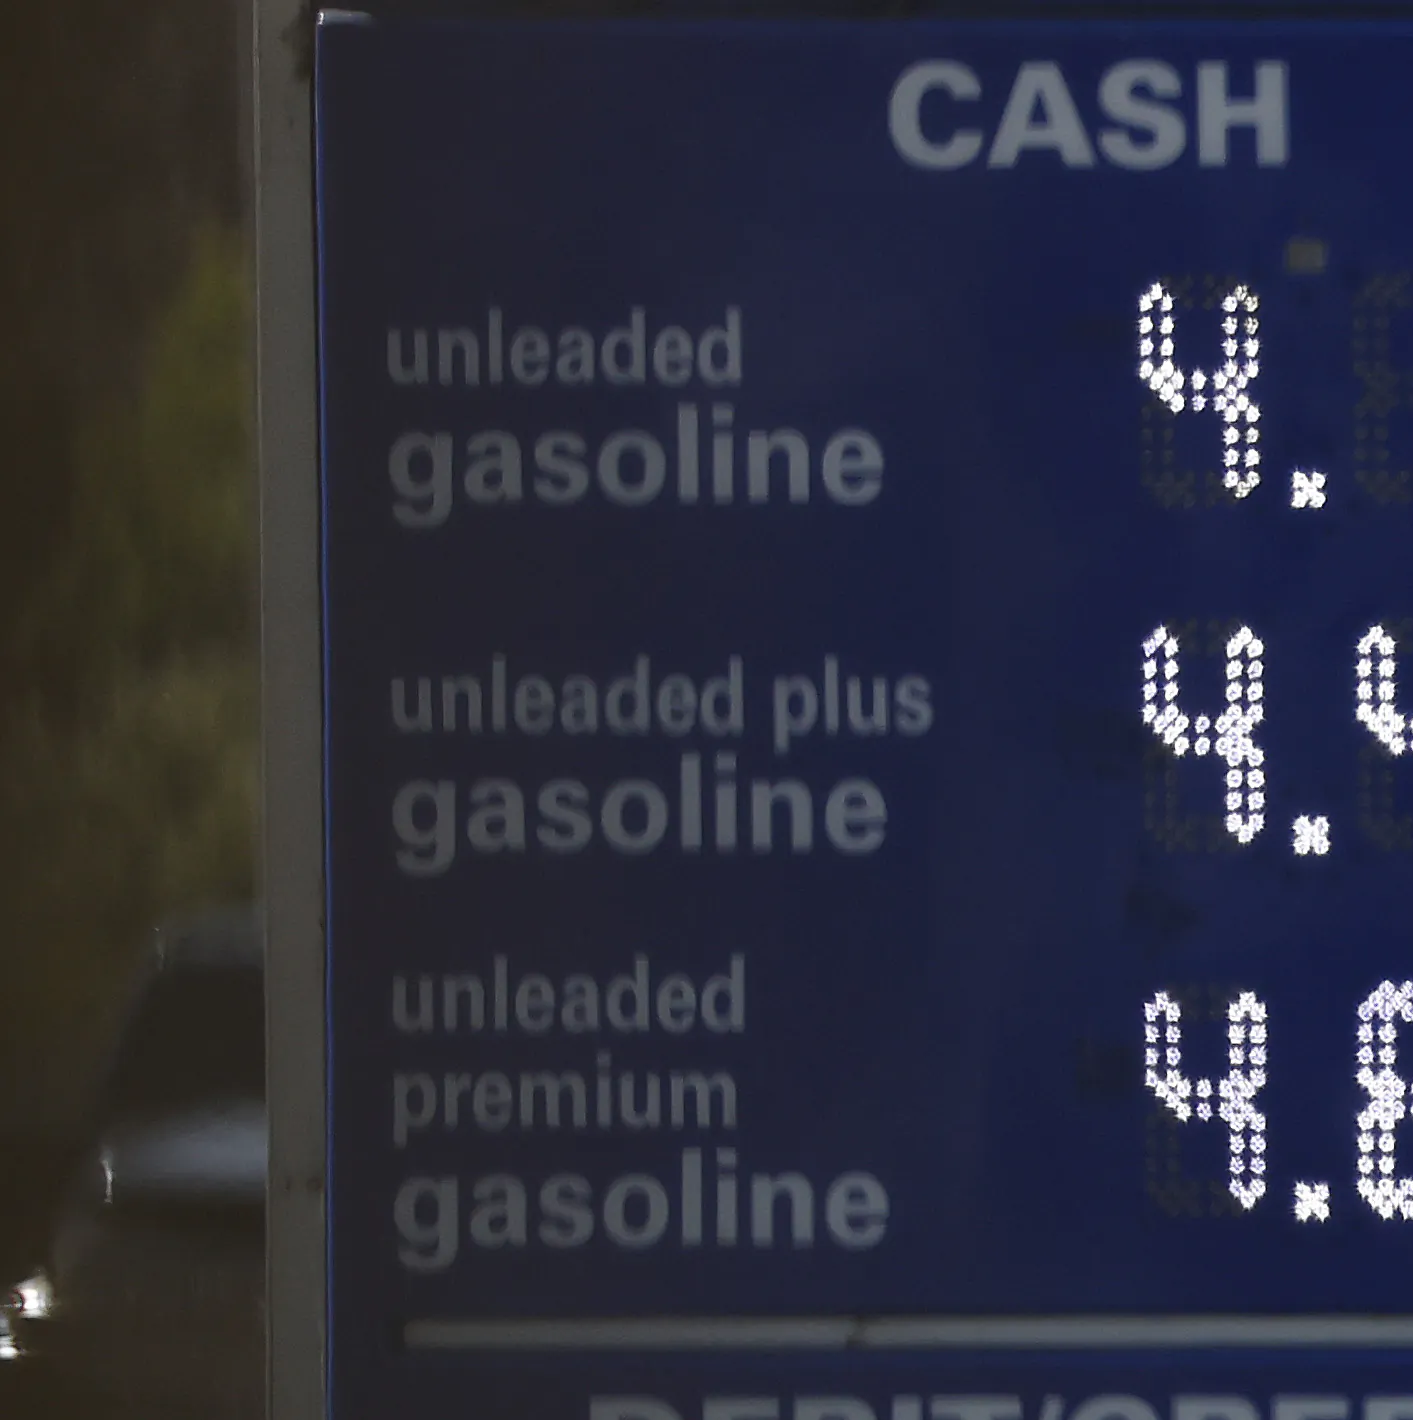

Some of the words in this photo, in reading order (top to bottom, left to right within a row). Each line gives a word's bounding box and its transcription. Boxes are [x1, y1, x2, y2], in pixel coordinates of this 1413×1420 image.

[888, 58, 1290, 171] CASH
[387, 304, 742, 387] unleaded
[388, 401, 885, 529] gasoline
[390, 652, 744, 737] unleaded
[773, 652, 935, 757] plus
[391, 749, 889, 878] gasoline
[392, 951, 747, 1034] unleaded
[392, 1049, 738, 1150] premium
[393, 1144, 892, 1275] gasoline
